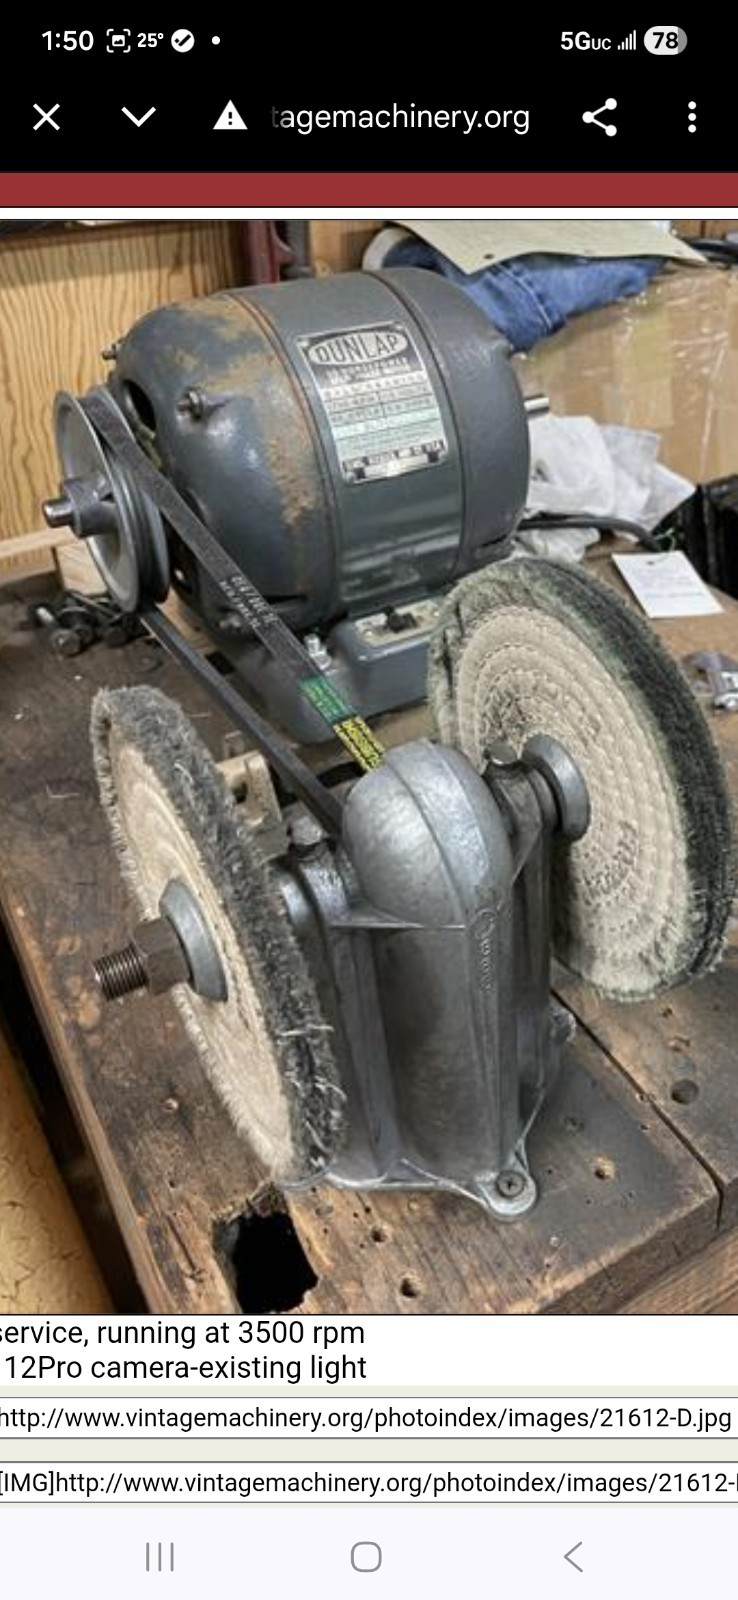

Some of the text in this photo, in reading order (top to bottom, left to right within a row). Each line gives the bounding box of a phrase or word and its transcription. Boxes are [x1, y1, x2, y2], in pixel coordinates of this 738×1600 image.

[42, 30, 163, 51] 1:50 25°
[652, 31, 679, 50] 78
[315, 332, 398, 362] DUNLAP
[0, 1321, 364, 1349] ervice, running at 3500 rpm
[6, 1355, 366, 1384] 12Pro camera-existing light
[0, 1406, 731, 1433] http://www.vintagemachinery.org/photoindex/images/21612-D.jpg
[0, 1471, 738, 1498] [IMG]http://www.vintagemachinery.org/photoindex/images/21612-
